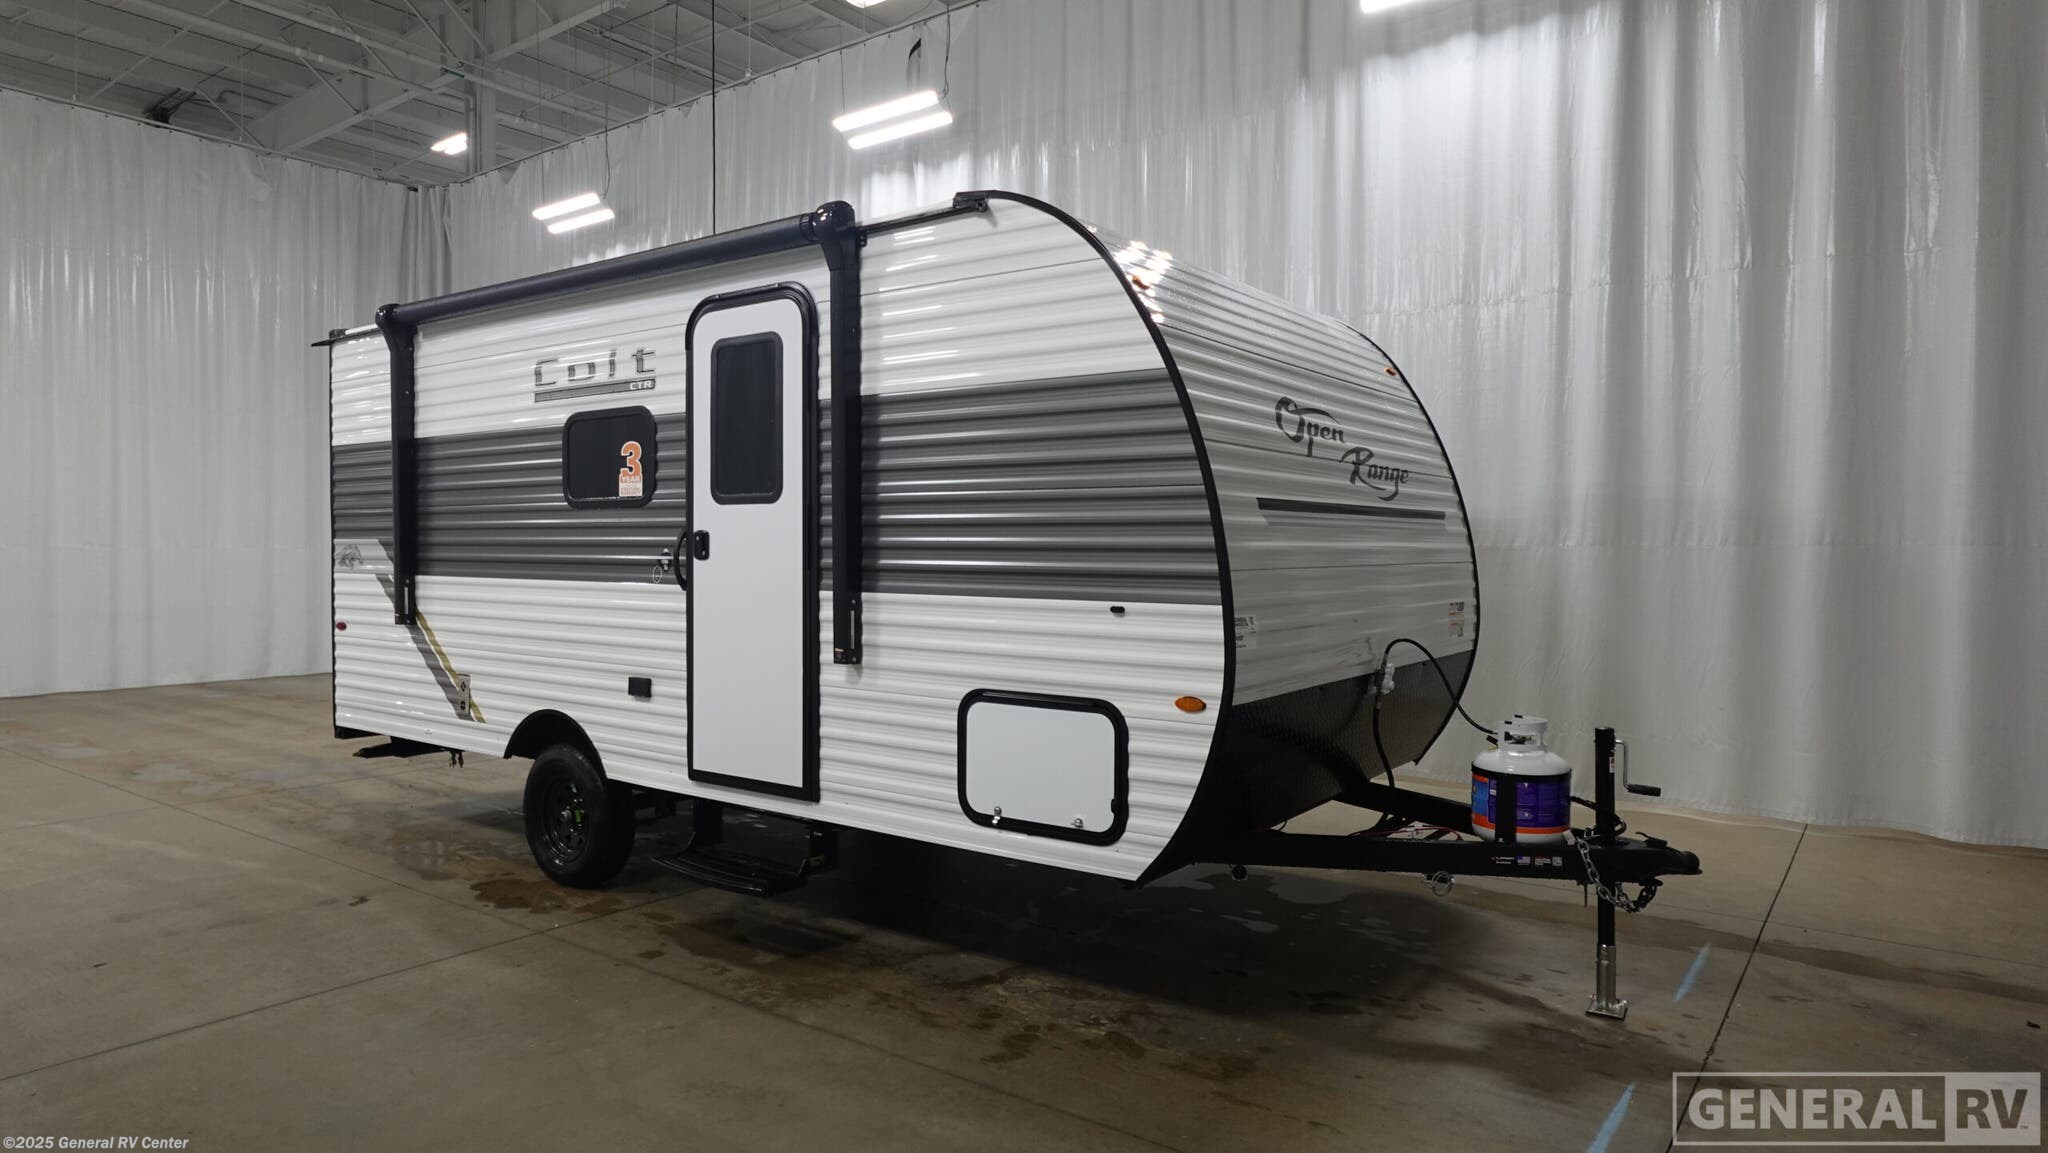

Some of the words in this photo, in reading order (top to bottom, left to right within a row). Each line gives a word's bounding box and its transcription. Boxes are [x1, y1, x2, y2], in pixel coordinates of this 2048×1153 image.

[533, 349, 655, 386] Colt
[629, 380, 653, 390] CTR
[1275, 396, 1346, 457] Open
[620, 441, 642, 477] 3
[1339, 447, 1409, 501] Range
